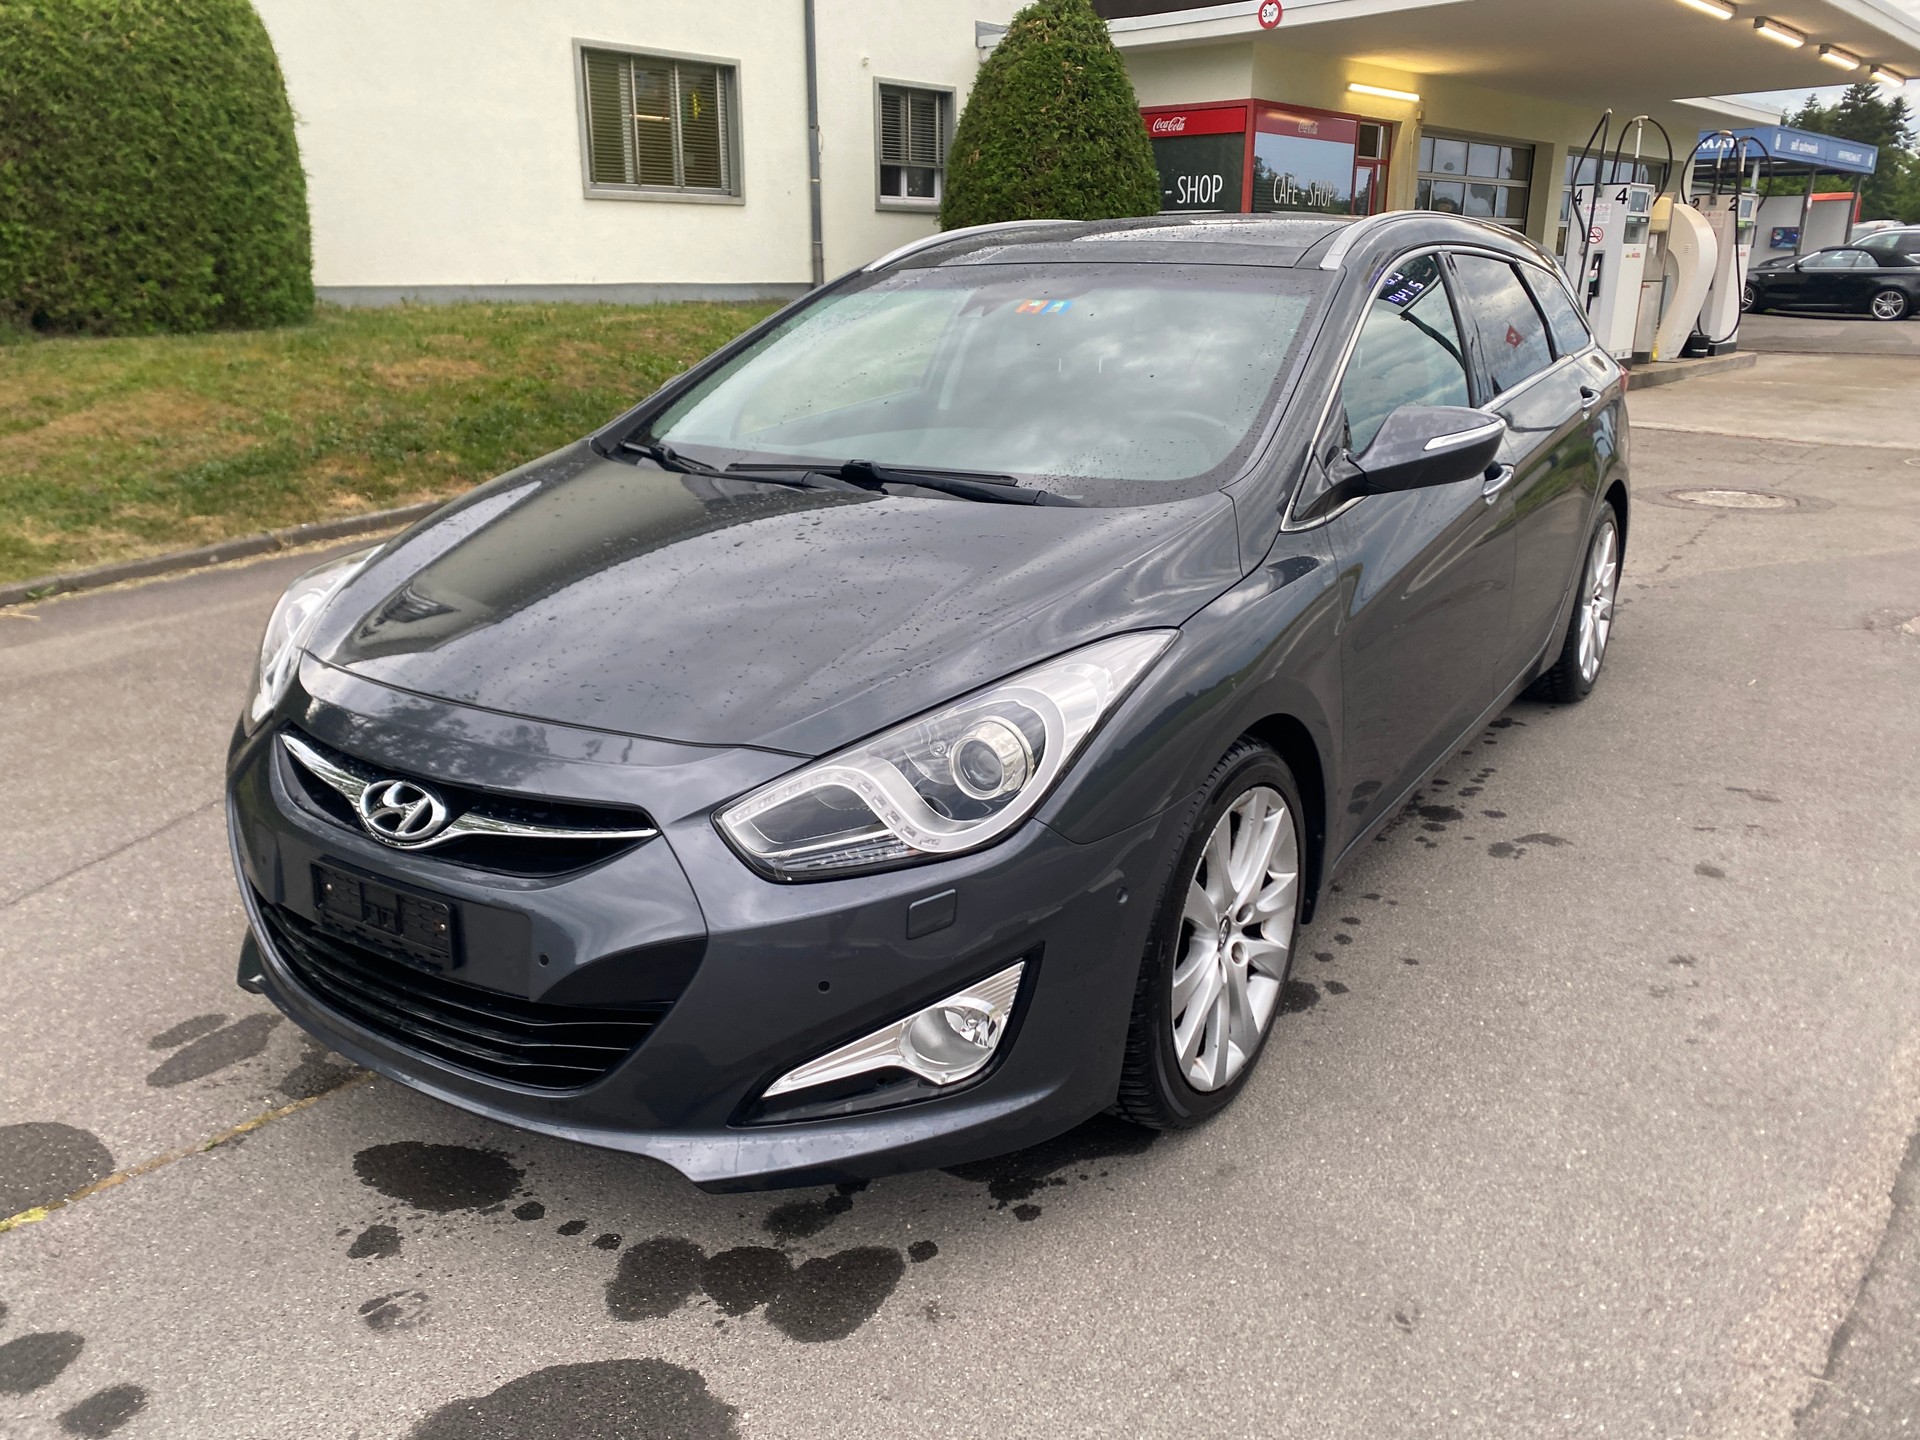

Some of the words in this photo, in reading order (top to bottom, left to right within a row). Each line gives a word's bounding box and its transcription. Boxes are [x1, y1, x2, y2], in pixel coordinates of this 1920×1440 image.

[1176, 174, 1223, 204] SHOP
[1307, 179, 1335, 207] SHOP
[1575, 188, 1583, 206] 4
[1615, 187, 1628, 205] 4
